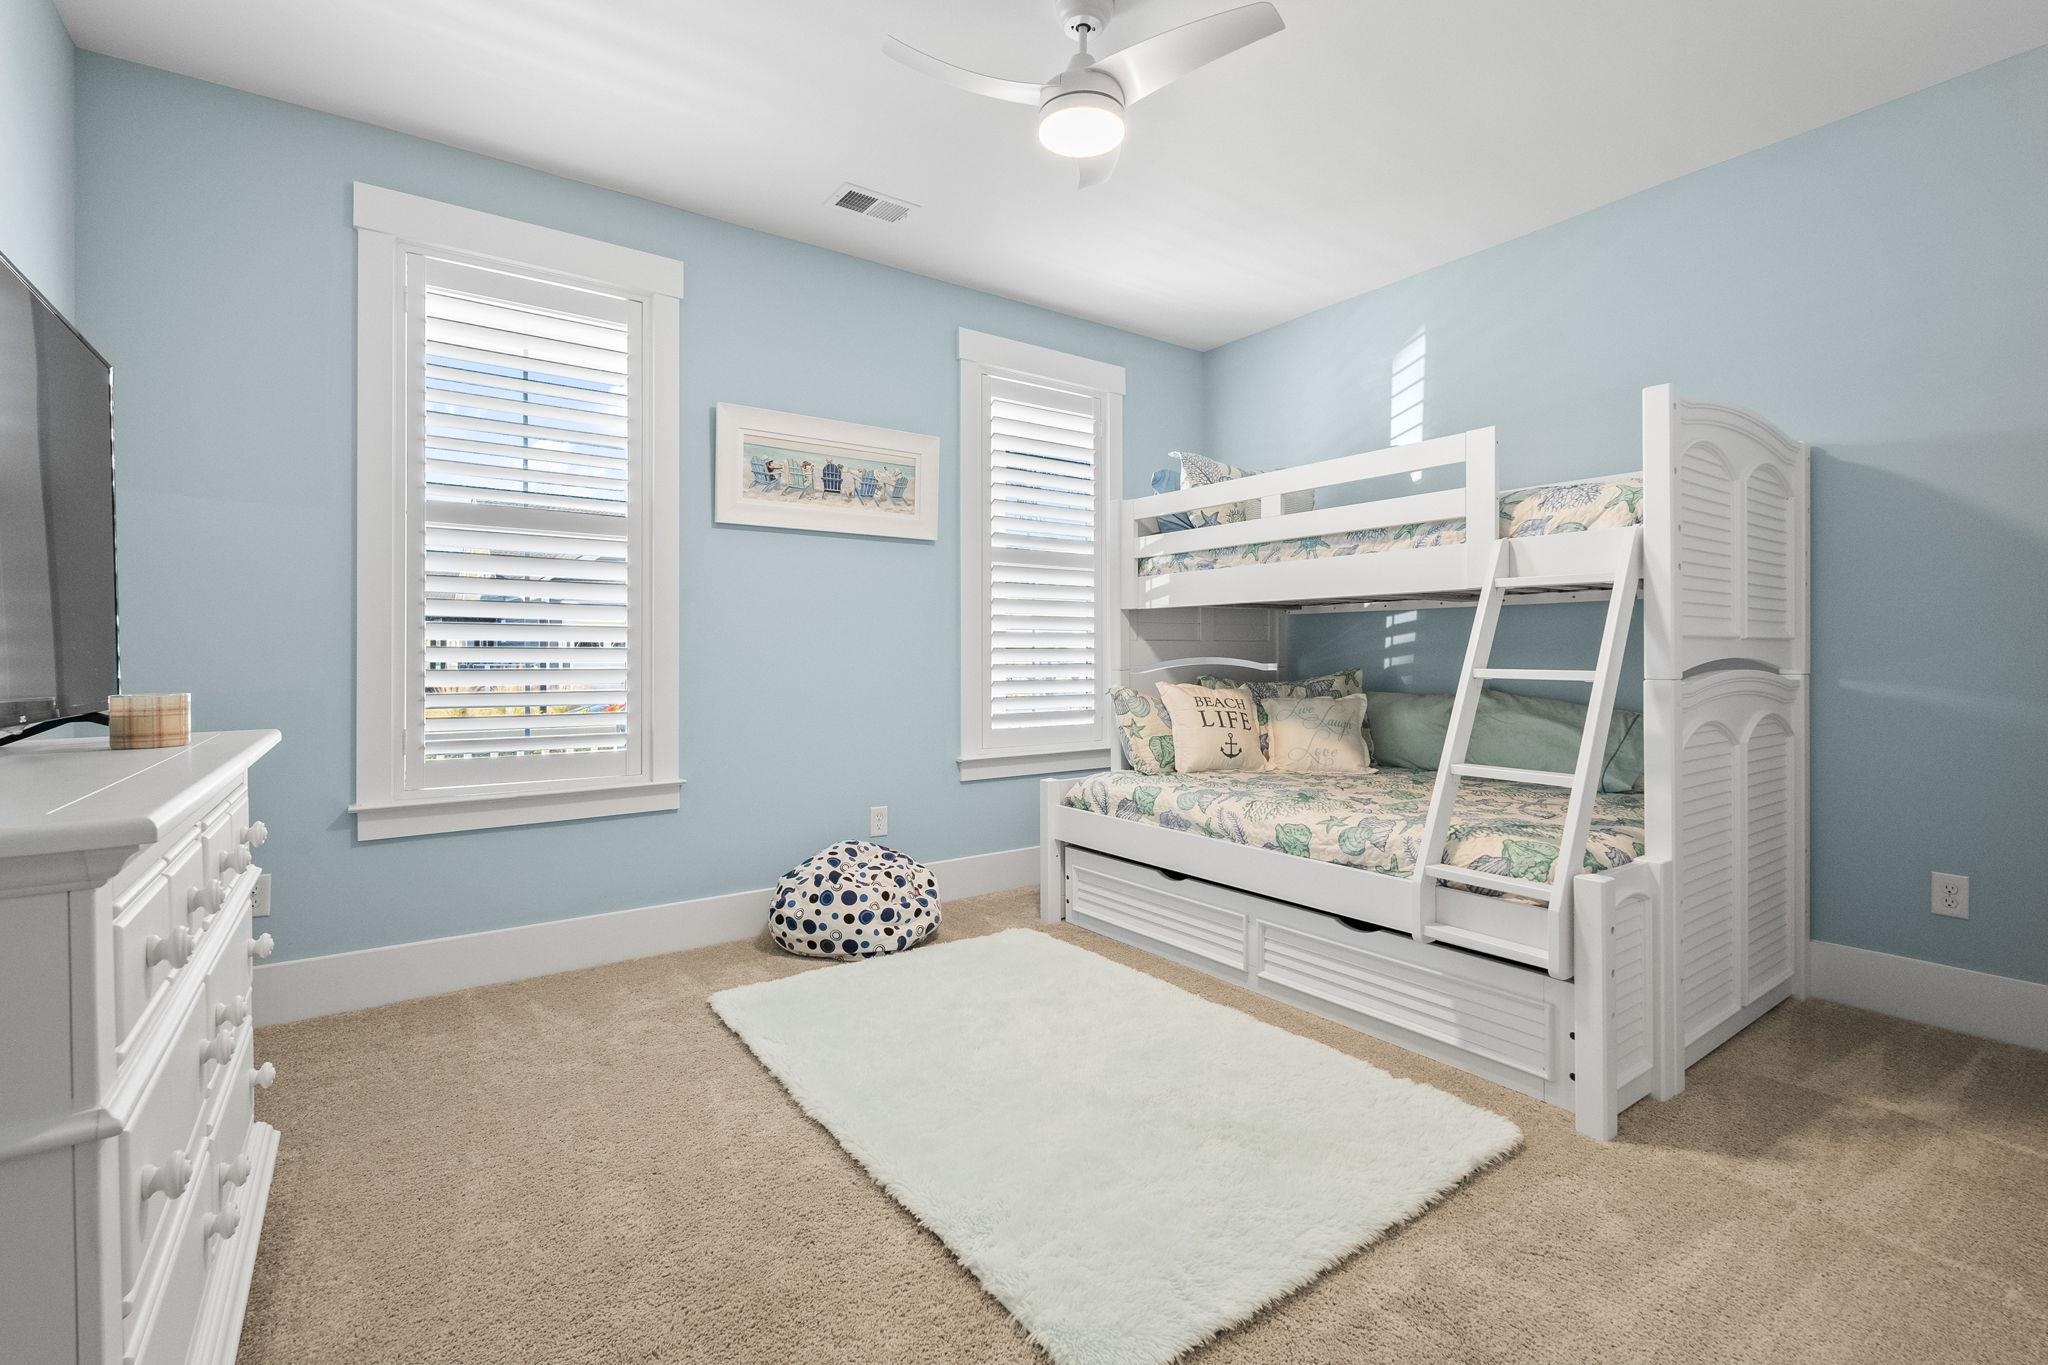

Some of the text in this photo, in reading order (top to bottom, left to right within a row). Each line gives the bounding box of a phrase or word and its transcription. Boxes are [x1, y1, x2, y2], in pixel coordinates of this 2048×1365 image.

[1195, 696, 1246, 710] BEACH
[1277, 699, 1315, 720] Live
[1200, 711, 1252, 731] LIFE
[1303, 705, 1354, 740] Laugh
[1288, 731, 1338, 765] Love
